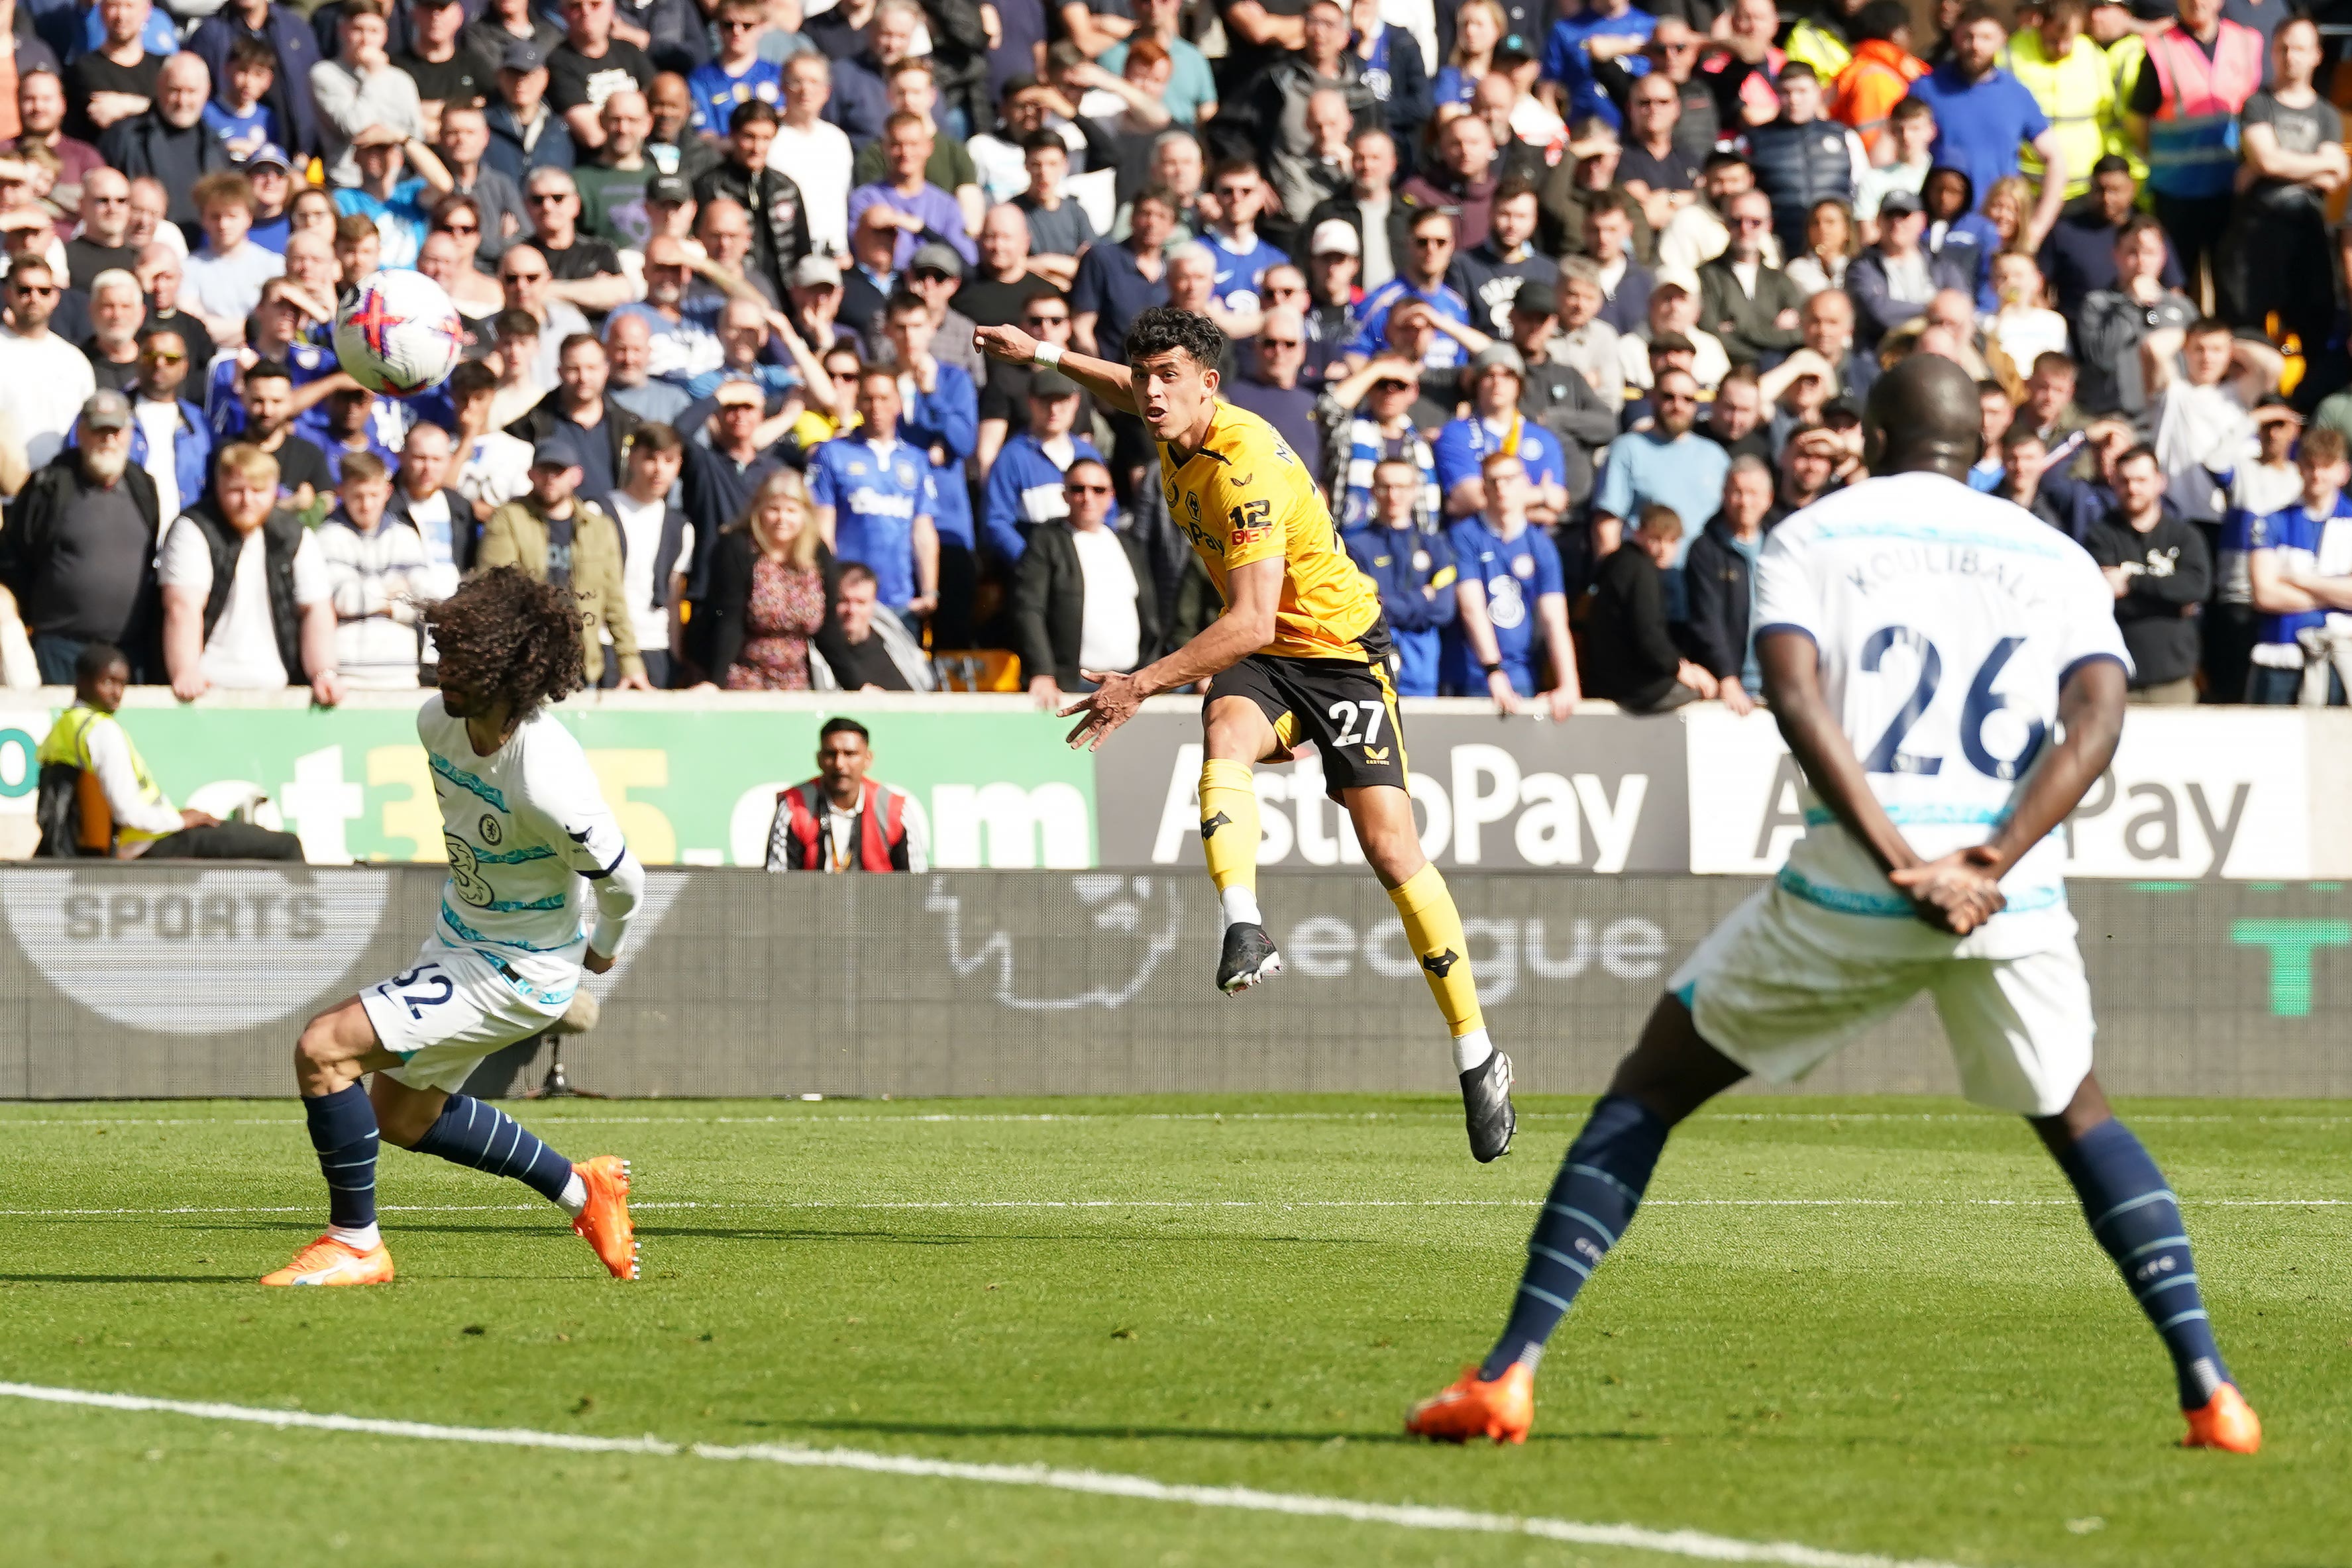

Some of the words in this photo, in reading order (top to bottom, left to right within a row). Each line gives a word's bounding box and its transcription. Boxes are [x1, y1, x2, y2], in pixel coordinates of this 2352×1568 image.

[1229, 499, 1272, 529] 12
[1230, 527, 1273, 546] BET
[1846, 542, 2047, 608] KOULIBALY
[1328, 700, 1385, 747] 27
[1860, 625, 2047, 781] 26
[66, 892, 323, 941] SPORTS
[1287, 914, 1670, 1007] eague
